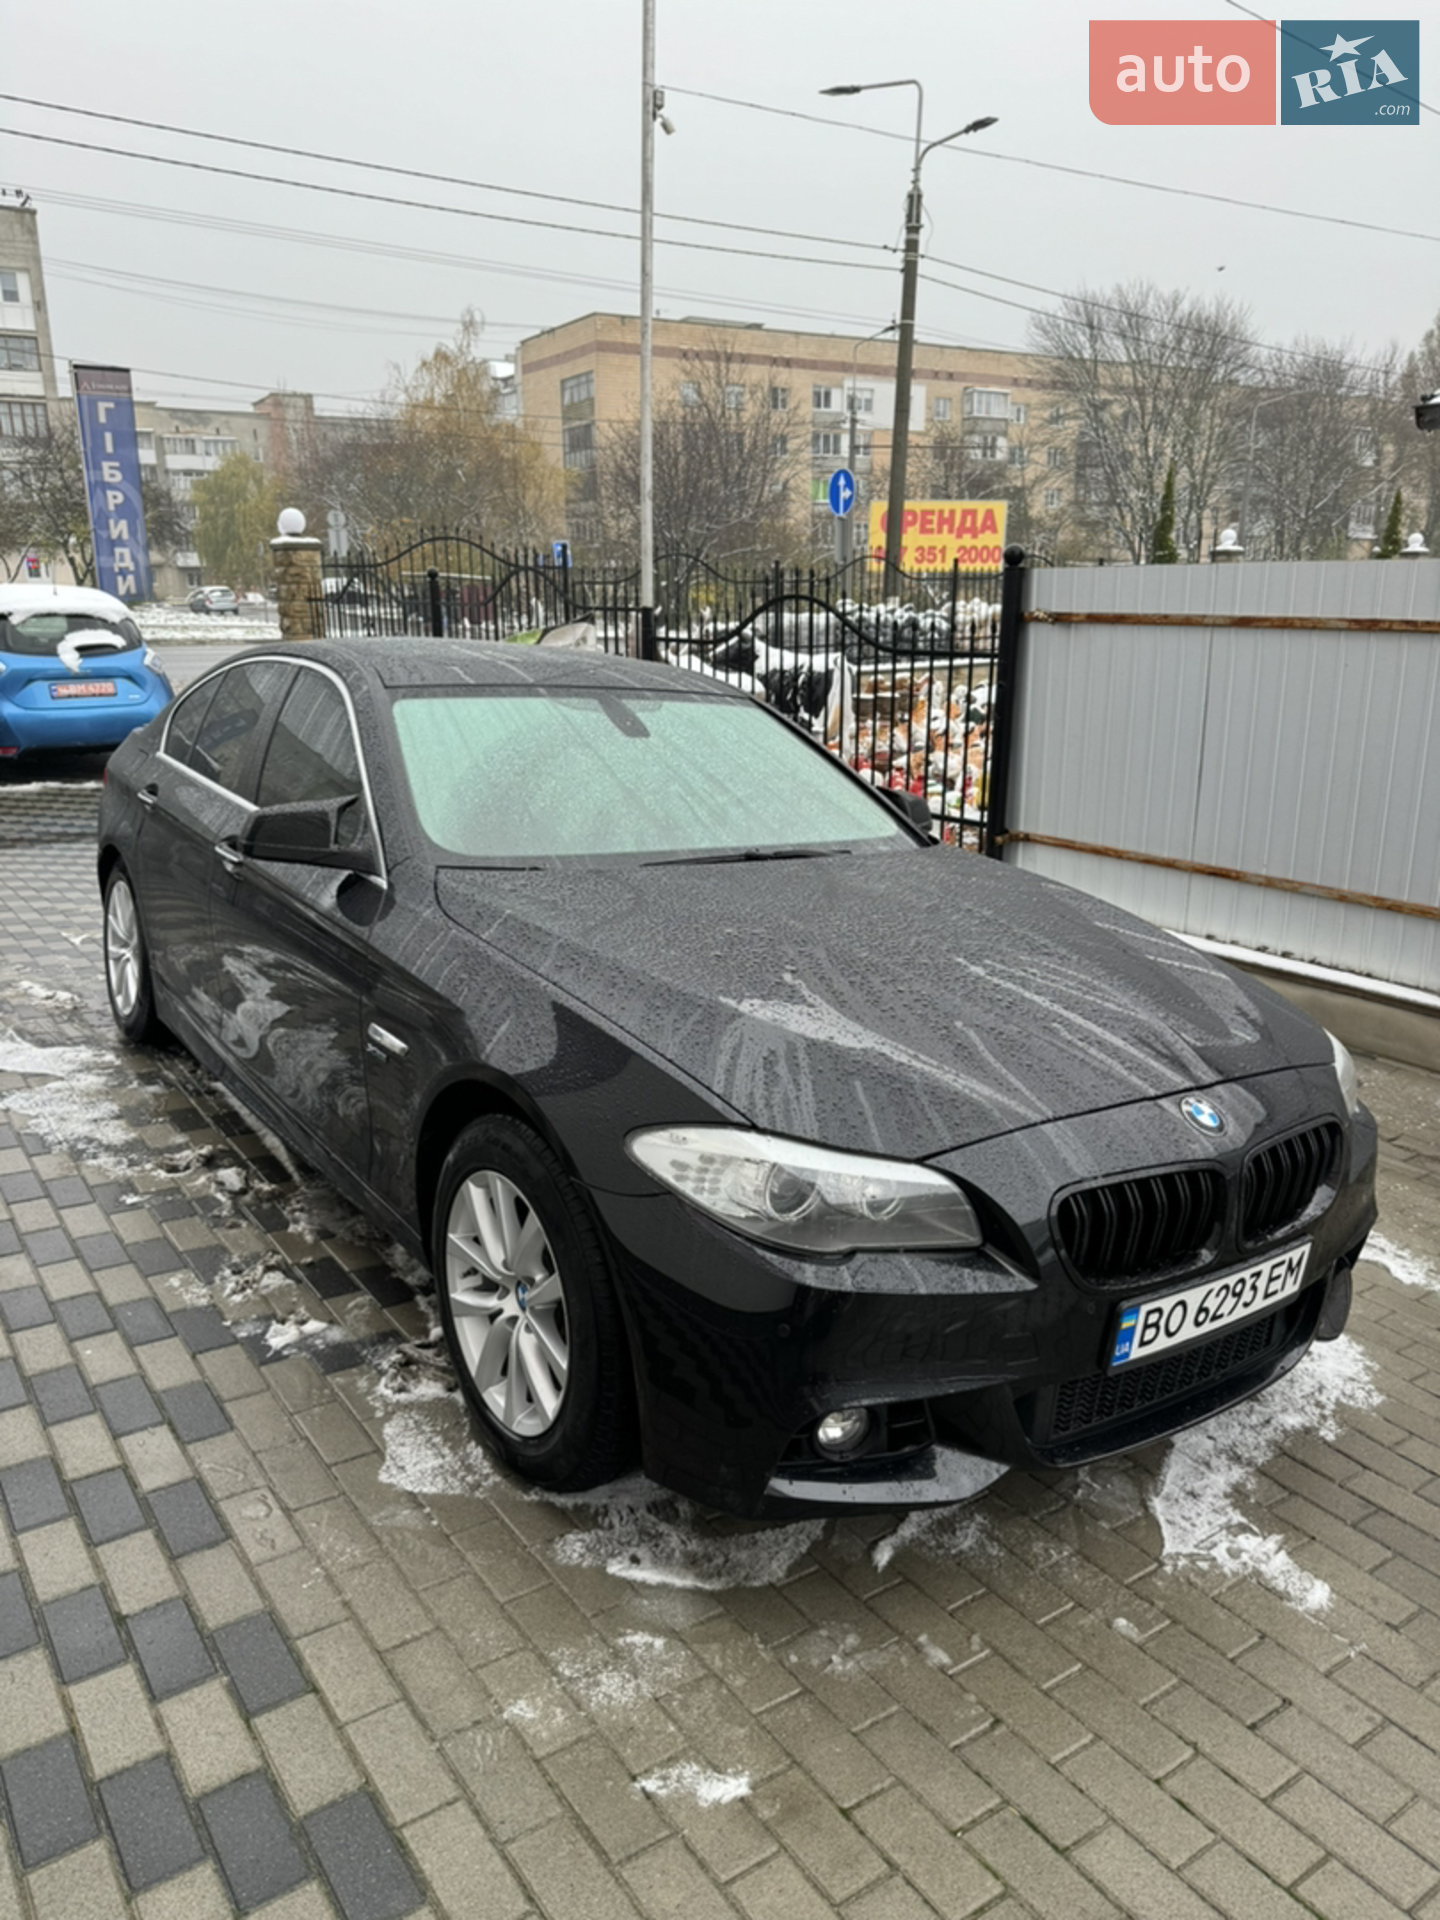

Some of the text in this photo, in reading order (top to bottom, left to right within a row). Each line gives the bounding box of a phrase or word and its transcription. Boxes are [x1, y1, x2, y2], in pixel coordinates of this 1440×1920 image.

[96, 401, 137, 597] ГІБРИДИ
[914, 545, 947, 564] 351
[956, 545, 1002, 564] 2000
[1138, 1250, 1306, 1349] BO 6293 EM
